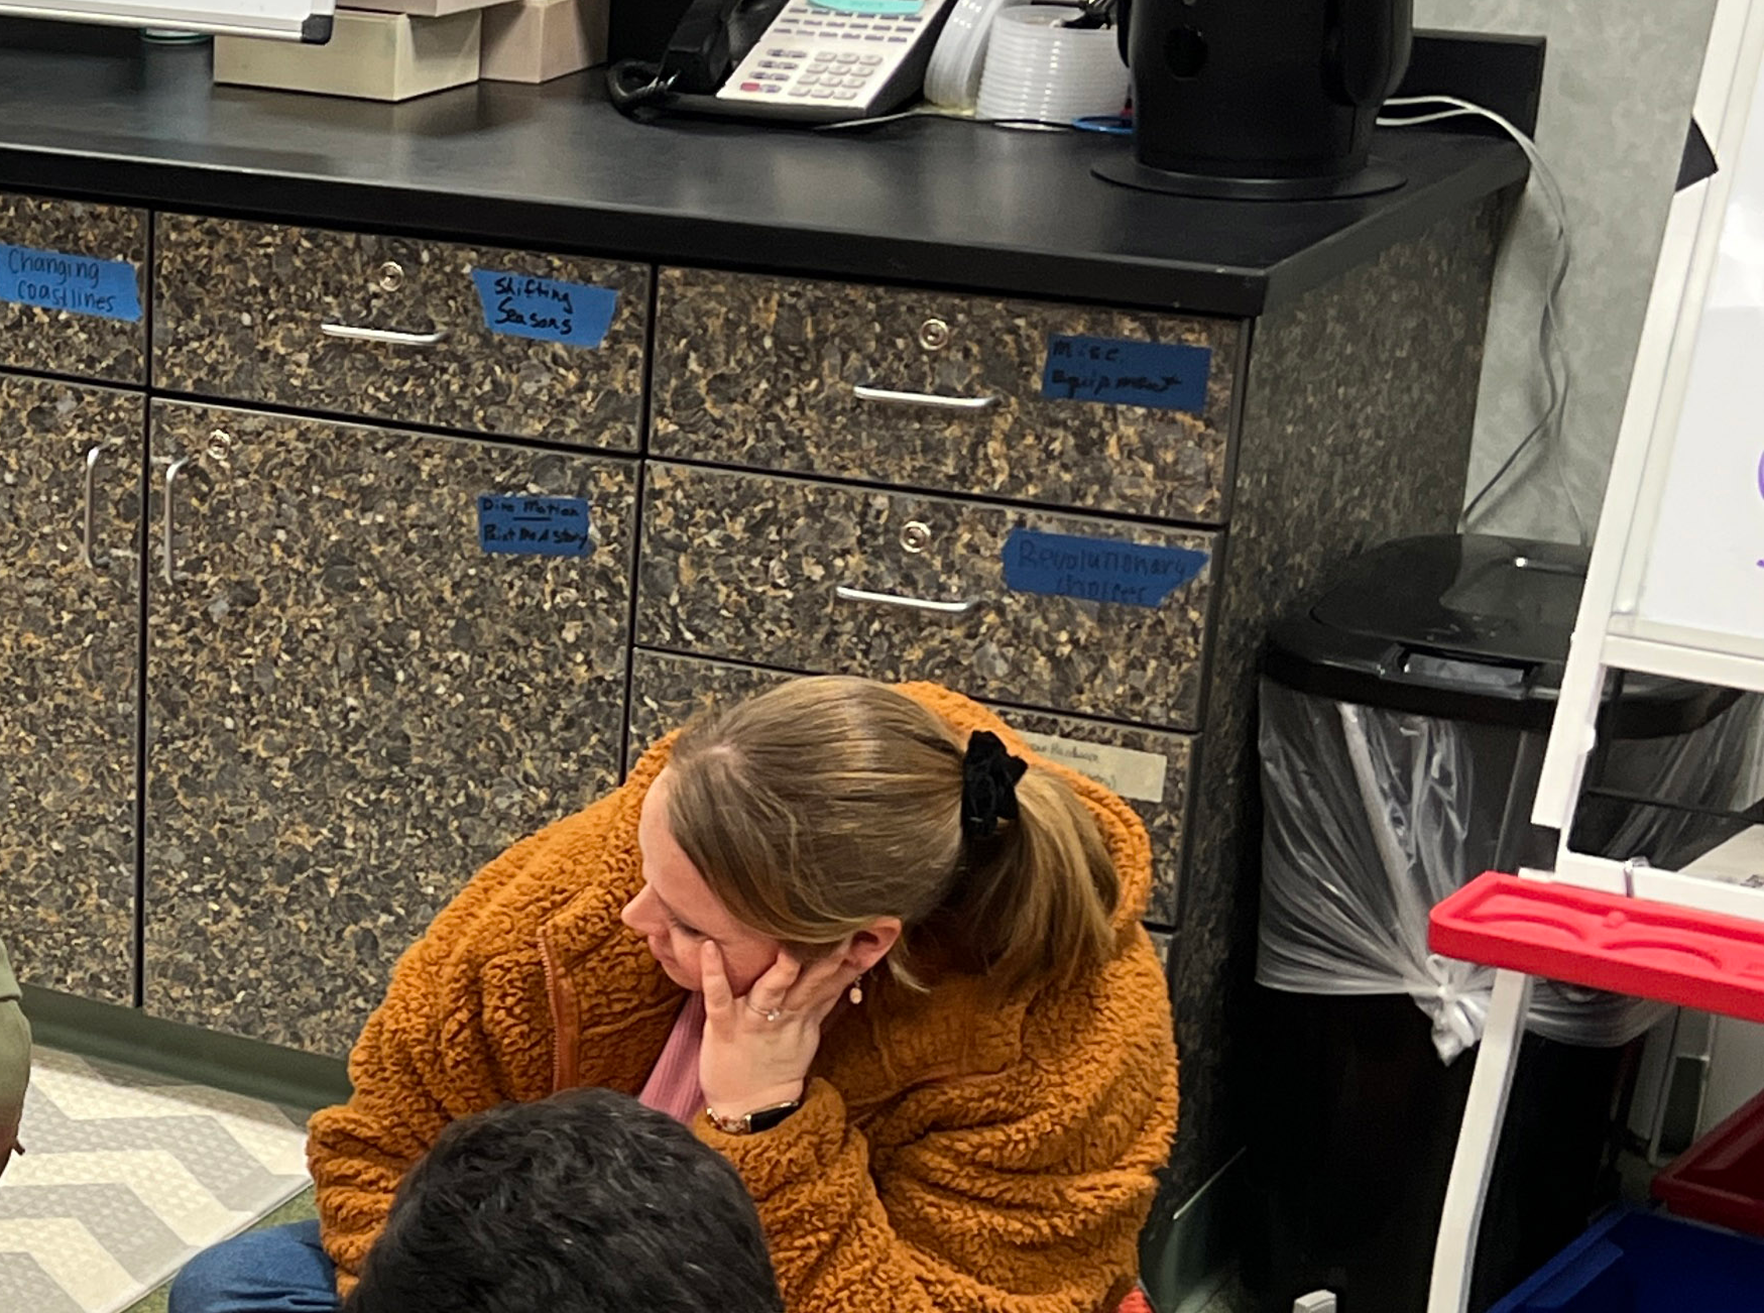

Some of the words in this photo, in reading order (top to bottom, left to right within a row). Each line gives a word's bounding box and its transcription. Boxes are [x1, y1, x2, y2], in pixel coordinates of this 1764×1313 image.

[8, 248, 100, 290] Changing
[494, 277, 574, 315] Shifting
[494, 296, 574, 336] Seasons
